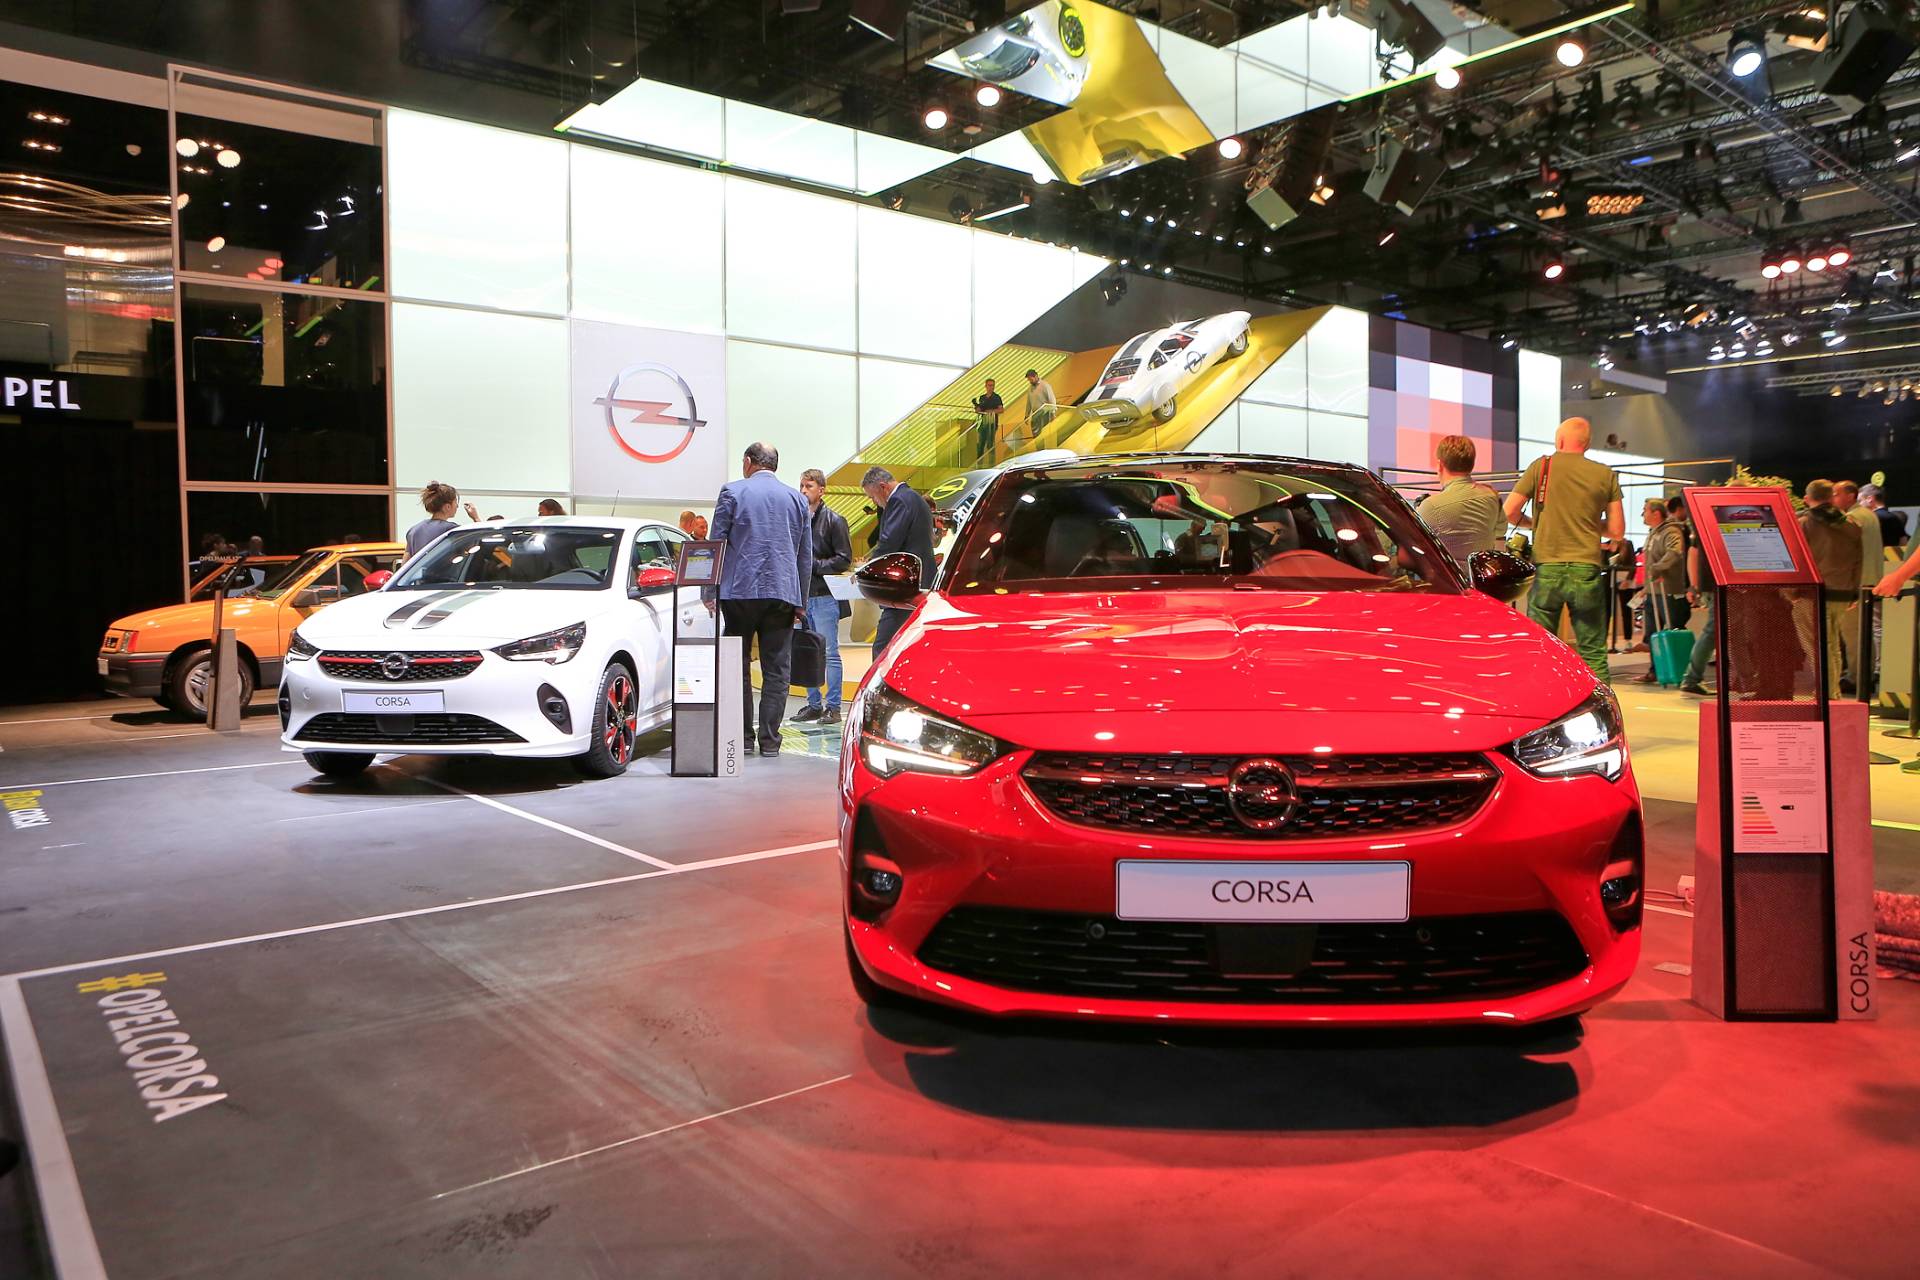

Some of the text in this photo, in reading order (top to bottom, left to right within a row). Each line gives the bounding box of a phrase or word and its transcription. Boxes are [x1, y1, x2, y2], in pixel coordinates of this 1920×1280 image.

[375, 696, 411, 707] CORSA
[726, 739, 736, 775] CORSA
[1211, 879, 1314, 904] CORSA
[1849, 931, 1870, 1013] CORSA
[76, 971, 228, 1123] #OPELCORSA
